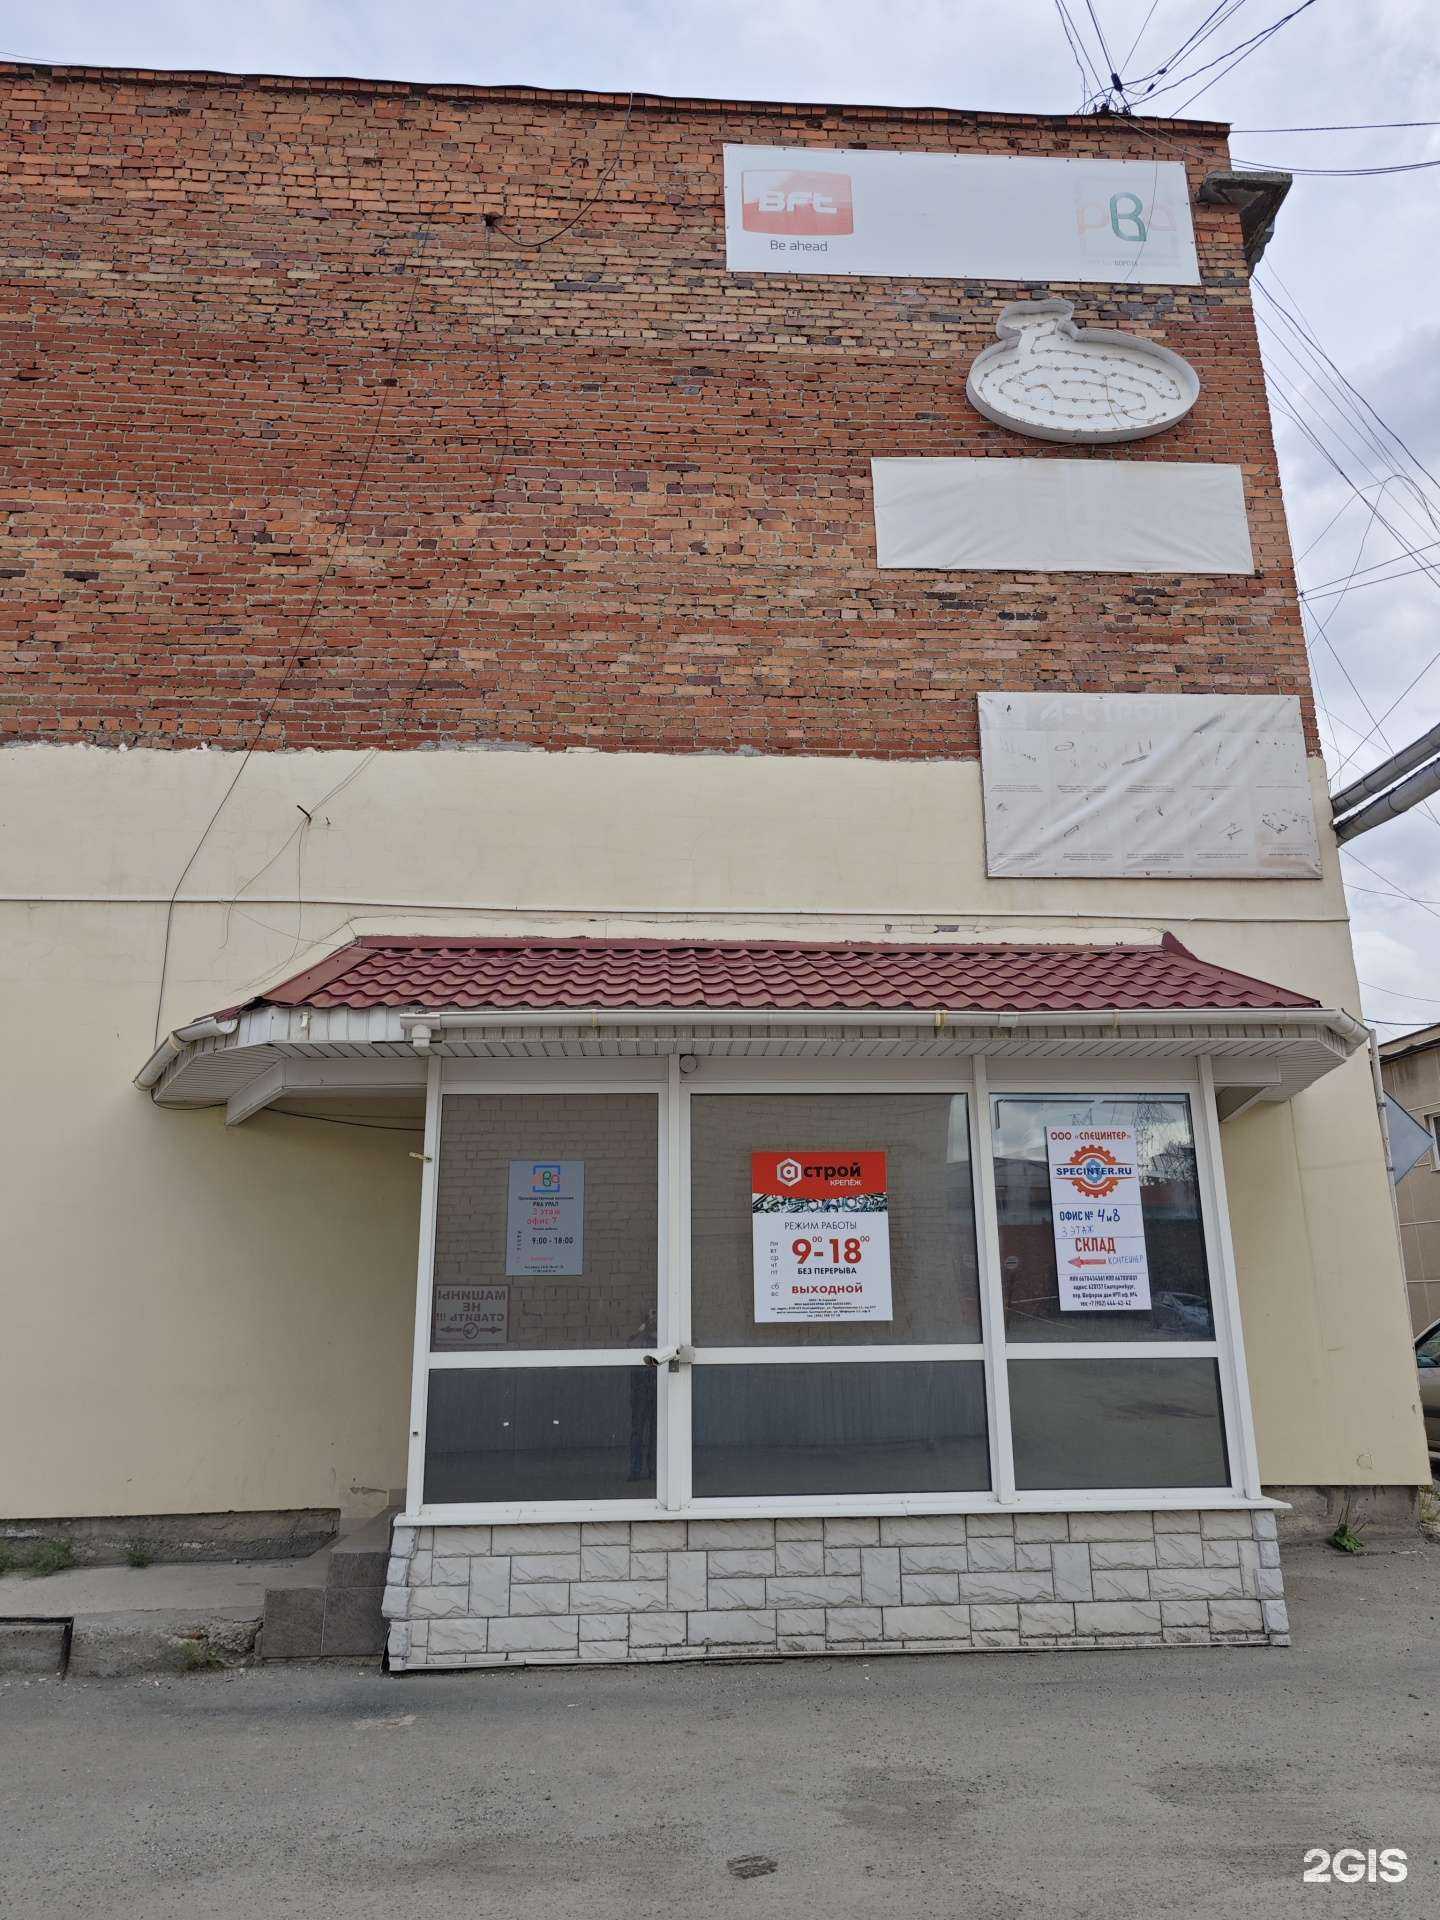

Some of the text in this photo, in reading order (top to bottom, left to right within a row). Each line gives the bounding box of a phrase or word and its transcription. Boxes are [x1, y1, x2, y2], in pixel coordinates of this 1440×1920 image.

[770, 240, 828, 252] Be ahead
[1050, 1131, 1072, 1140] ООО
[1056, 1167, 1132, 1176] SPECINTER.RU
[1059, 1210, 1083, 1221] ОФИС
[1084, 1210, 1093, 1221] №
[785, 1221, 857, 1230] РЕЖИМ РАБОТЫ
[1075, 1237, 1116, 1254] СКЛАД
[797, 1267, 857, 1275] БЕЗ ПЕРЕРЫВА
[792, 1282, 863, 1295] ВЫХОДНОЙ
